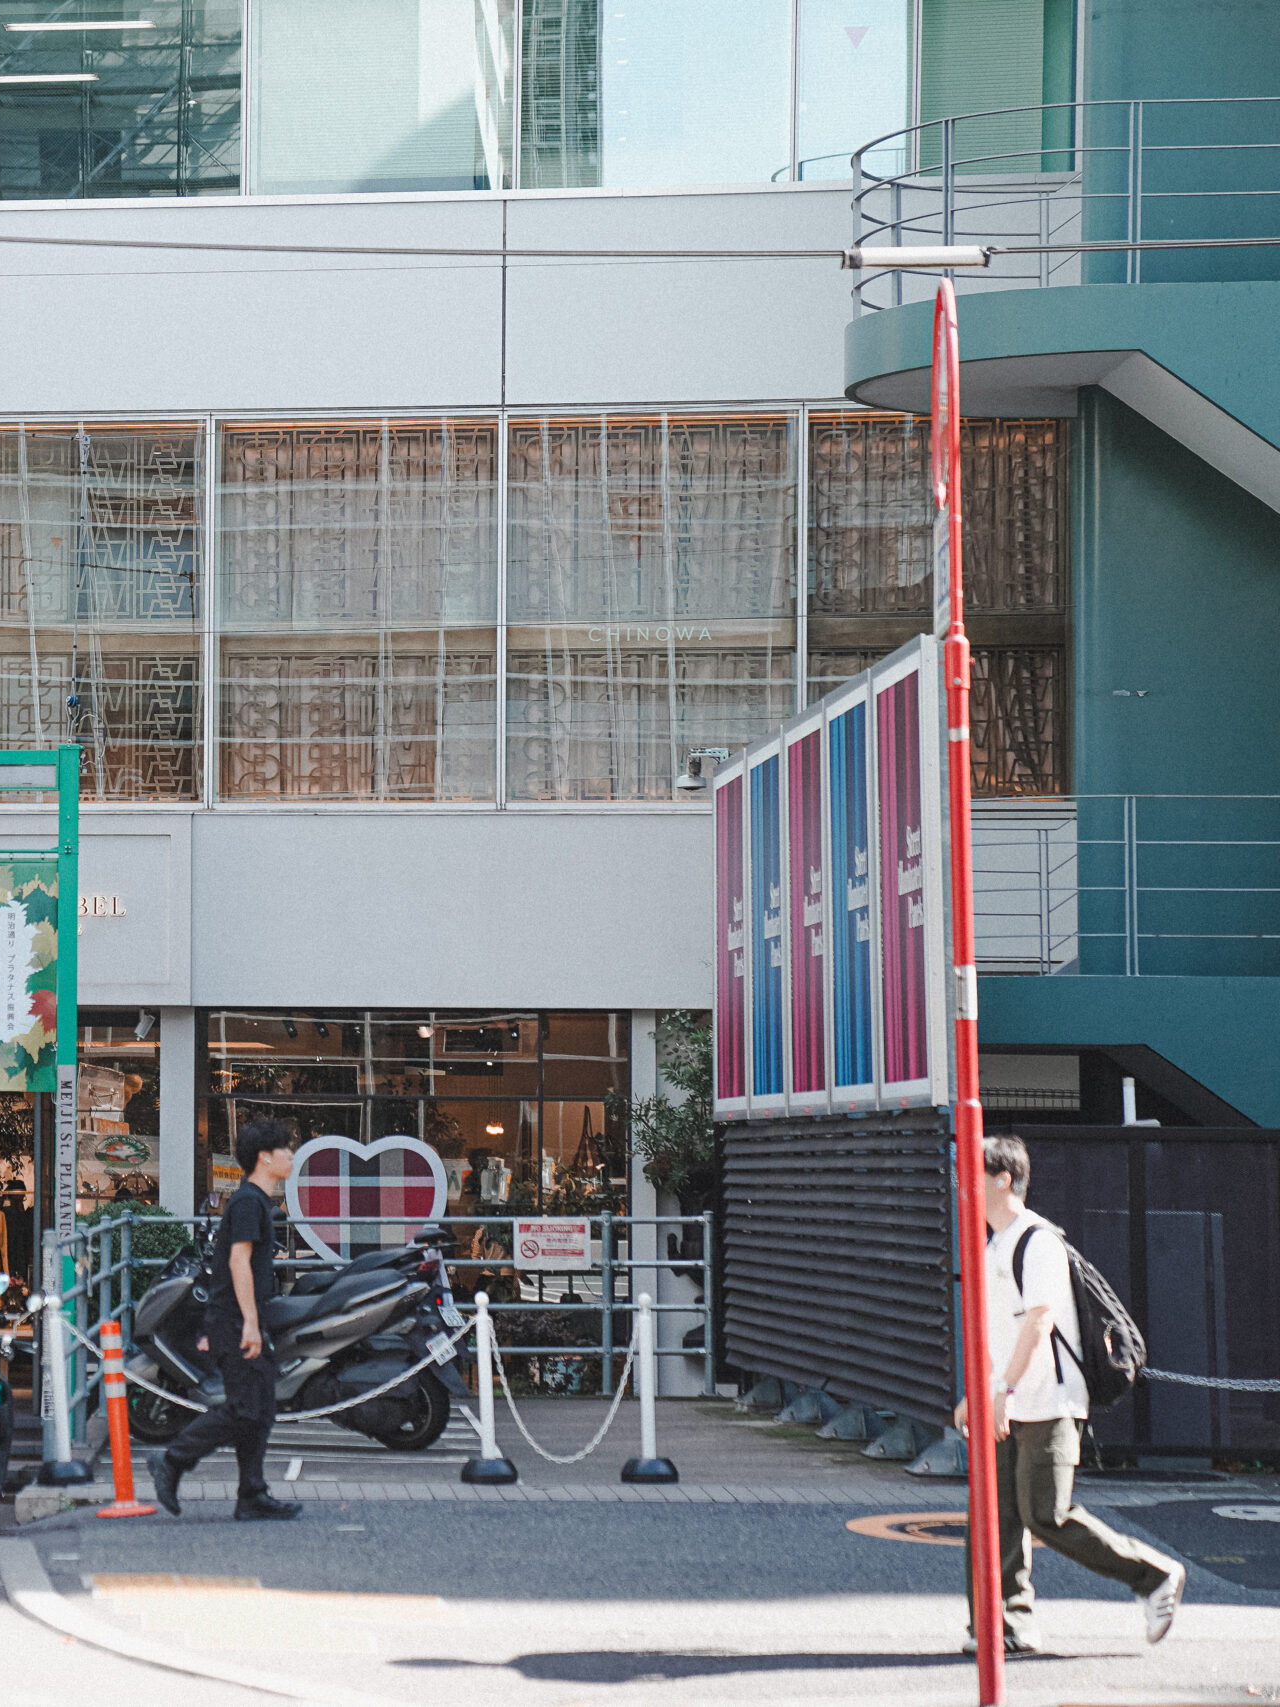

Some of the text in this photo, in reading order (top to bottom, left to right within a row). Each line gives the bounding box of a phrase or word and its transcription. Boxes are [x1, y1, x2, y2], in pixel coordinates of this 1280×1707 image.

[588, 626, 712, 642] CHINOWA
[77, 896, 126, 918] BEL
[60, 1080, 73, 1126] MEIJI
[60, 1132, 73, 1155] St.
